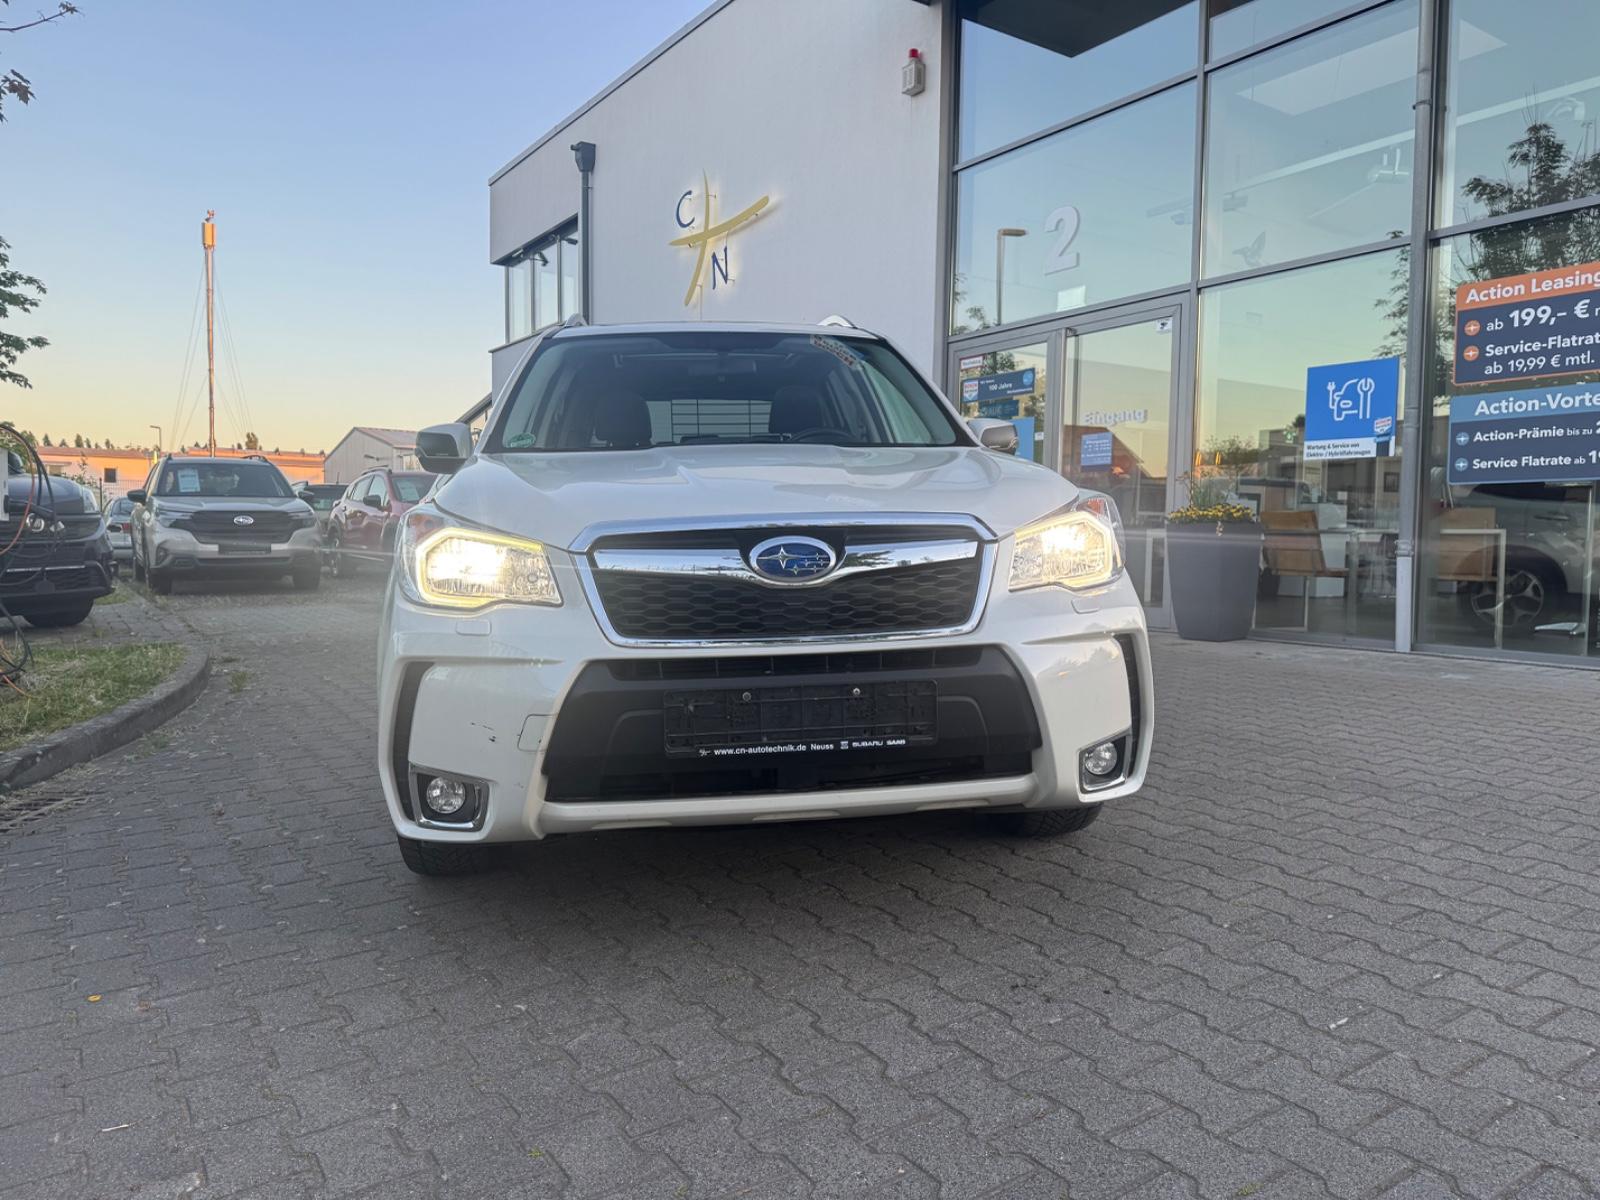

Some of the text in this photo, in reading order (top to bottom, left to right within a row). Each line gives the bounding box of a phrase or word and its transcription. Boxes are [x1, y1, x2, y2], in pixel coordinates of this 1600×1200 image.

[676, 190, 695, 228] C
[1044, 205, 1080, 276] 2
[711, 246, 728, 290] N
[1465, 283, 1525, 304] Action
[1486, 318, 1504, 331] ab
[1574, 298, 1591, 318] €
[1484, 350, 1595, 375] ab 19,99 € mtl.
[1084, 409, 1148, 427] Eingang
[1473, 426, 1564, 442] Action-Prämie
[1566, 427, 1580, 436] bis
[1472, 457, 1518, 470] Service
[1521, 455, 1572, 467] Flatrate
[1573, 456, 1586, 465] ab
[713, 743, 807, 756] www.cn-autotechnik.de
[810, 743, 834, 751] Neuss
[852, 740, 884, 748] SUBARU
